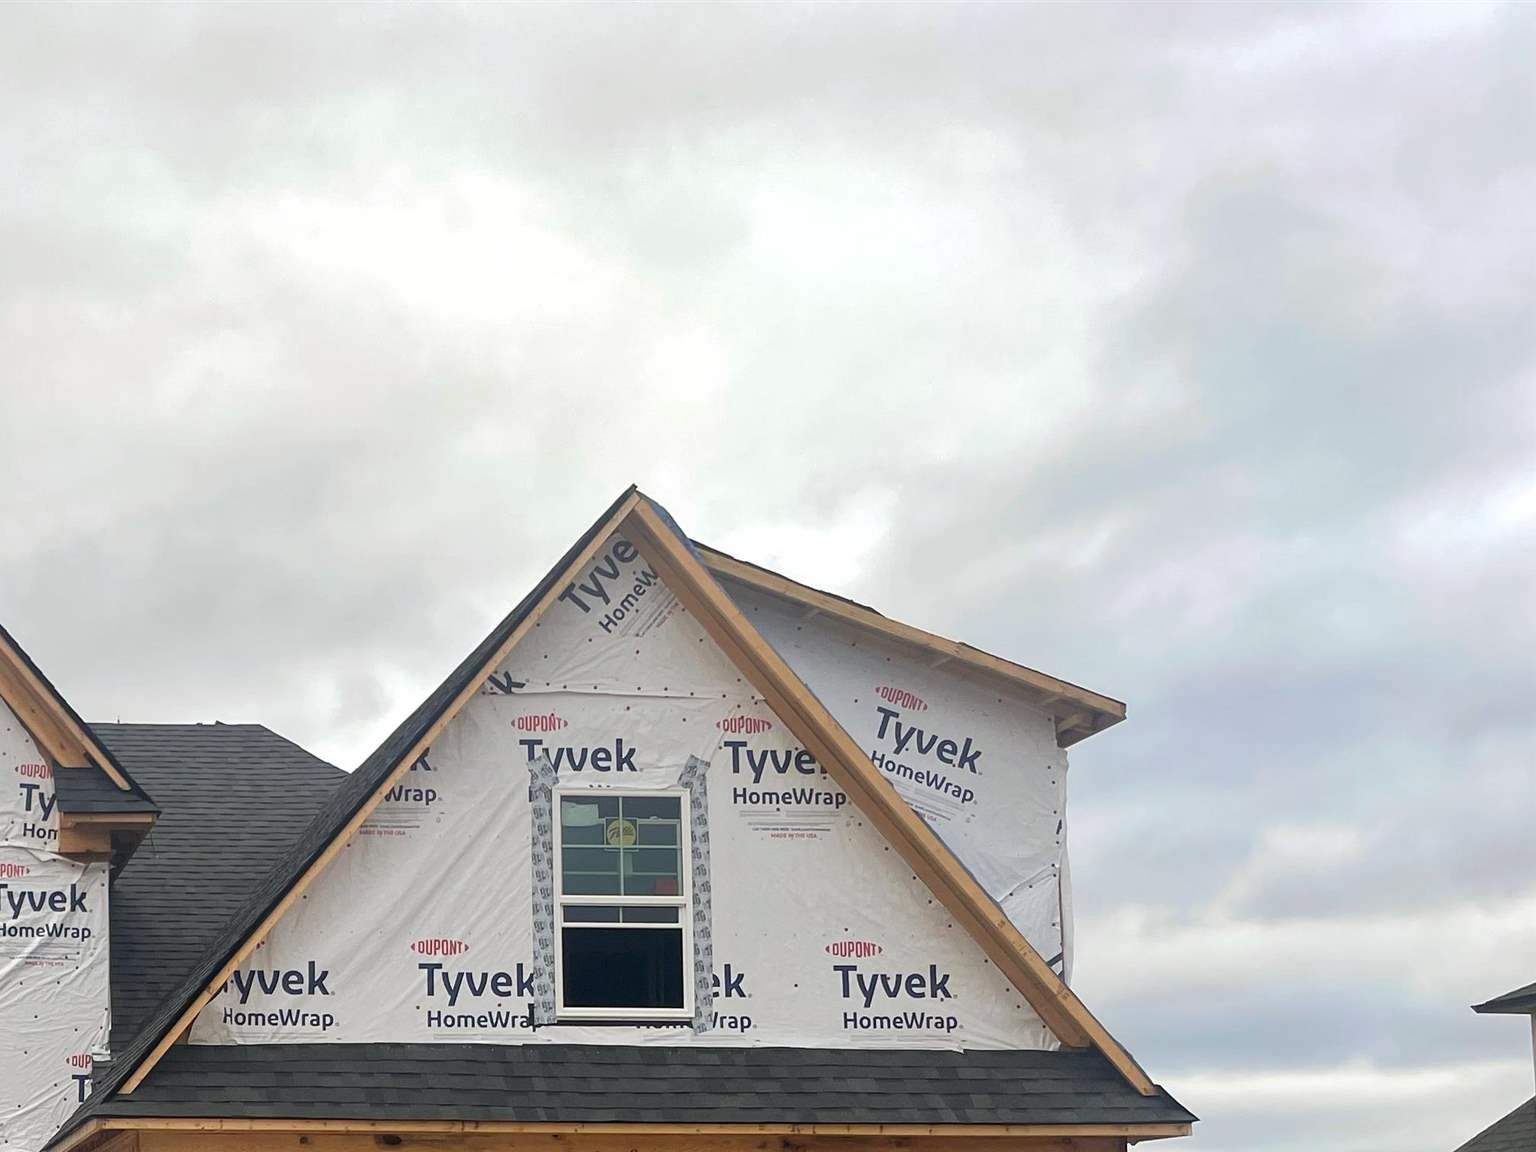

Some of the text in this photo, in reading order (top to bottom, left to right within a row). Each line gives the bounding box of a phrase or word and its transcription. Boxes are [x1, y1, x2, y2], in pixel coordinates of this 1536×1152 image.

[880, 687, 923, 712] DUPONT
[518, 715, 563, 732] DUPONT
[721, 717, 768, 734] DUPONT
[875, 706, 983, 775] Tyvek
[724, 741, 828, 784] Tyve
[871, 750, 975, 803] HomeWrap
[733, 787, 847, 810] HomeWrap
[418, 938, 463, 956] DUPONT
[832, 941, 877, 958] DUPONT
[224, 961, 330, 1006] yvek
[418, 962, 535, 1007] Tyvek
[833, 964, 952, 1007] Tyvek
[223, 1006, 335, 1030] HomeWrap
[843, 1012, 959, 1031] HomeWrap
